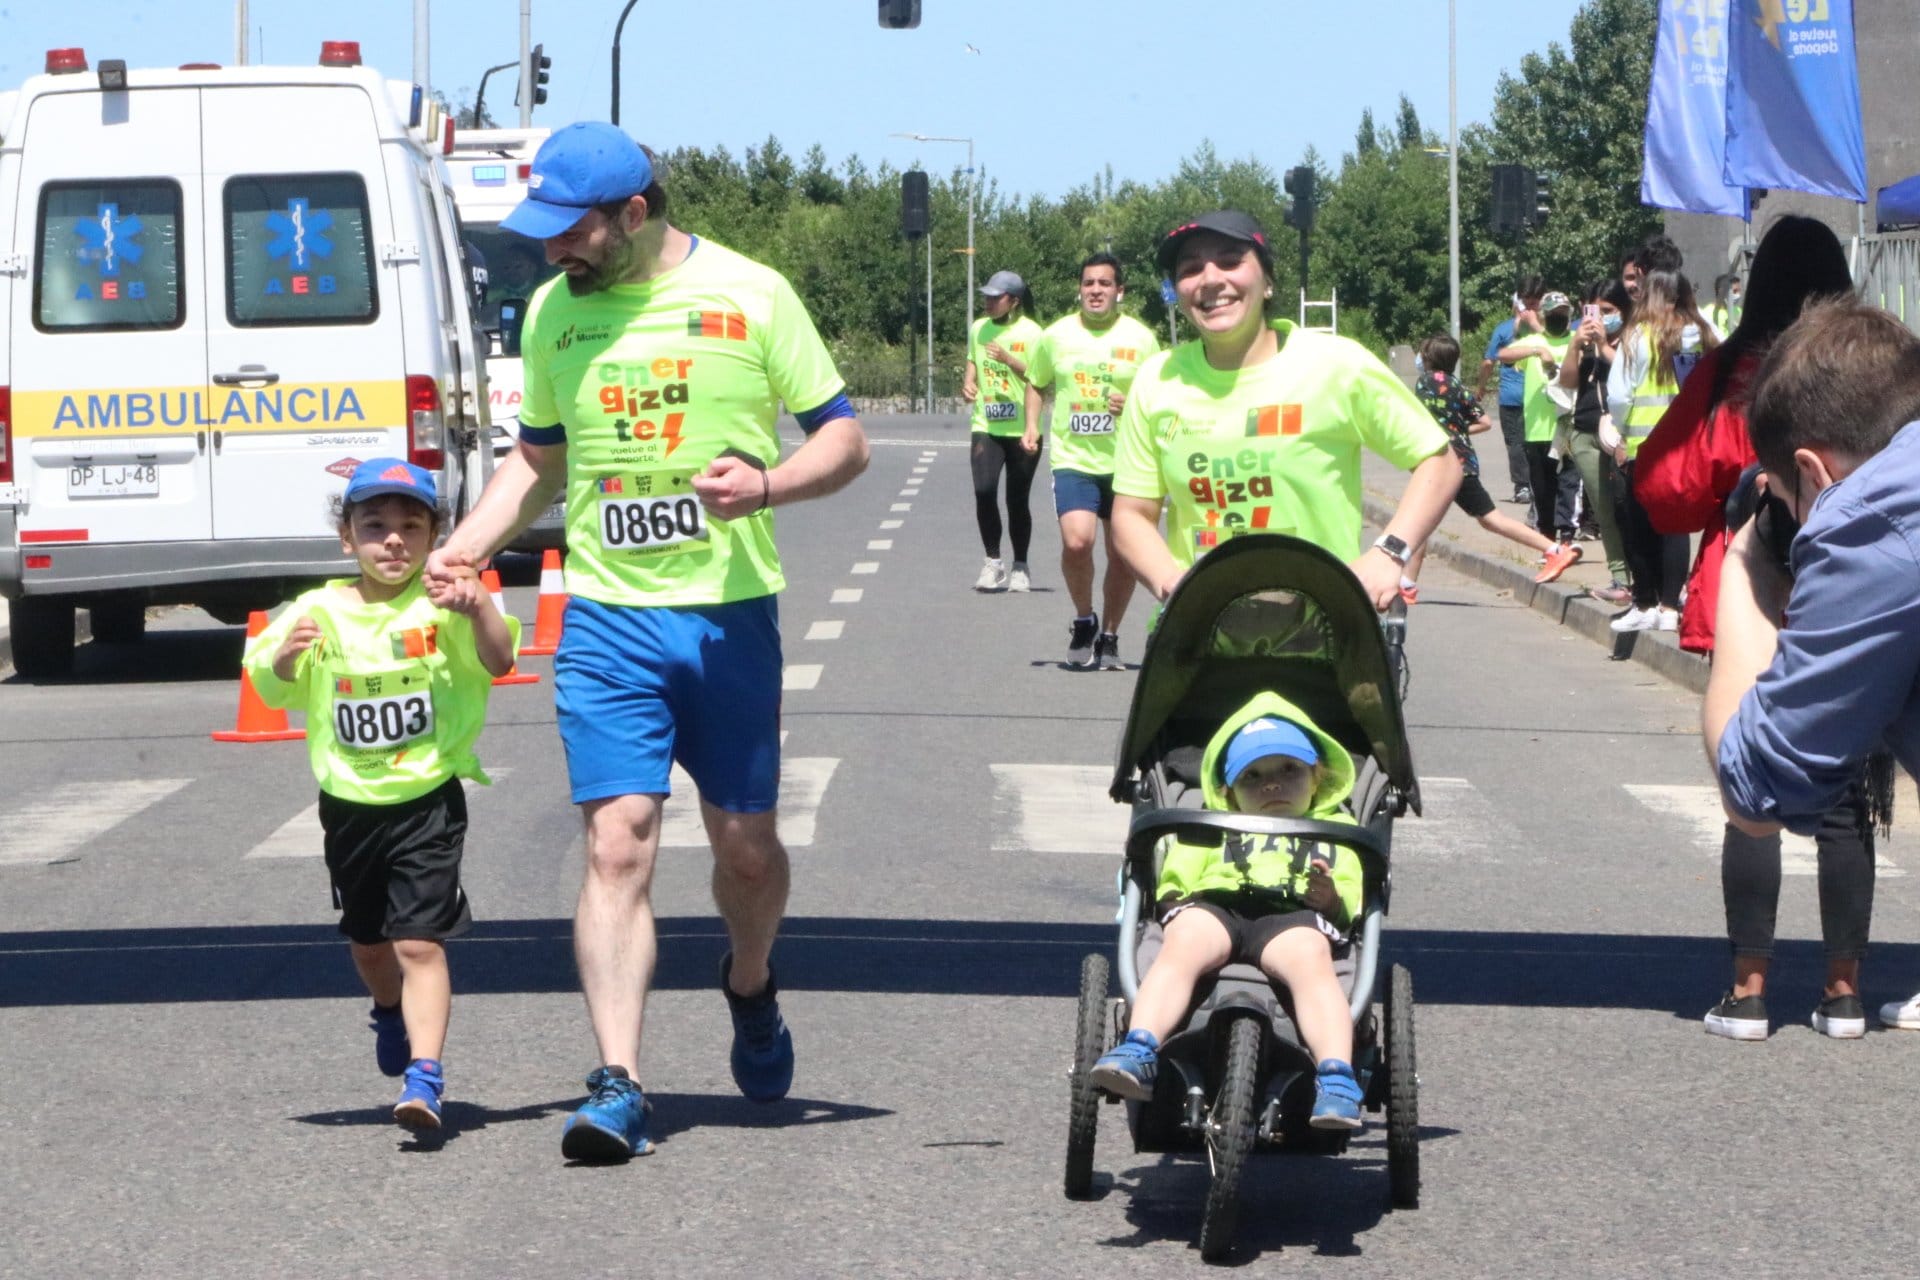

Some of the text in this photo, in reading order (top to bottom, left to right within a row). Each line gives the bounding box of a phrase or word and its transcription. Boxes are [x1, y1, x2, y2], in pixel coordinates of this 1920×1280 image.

[599, 358, 693, 386] ener
[53, 387, 365, 429] AMBULANCIA
[985, 403, 1014, 419] 0822
[614, 419, 656, 442] te
[1071, 414, 1112, 433] 0922
[1187, 449, 1276, 479] ener
[605, 498, 699, 545] 0860
[337, 697, 427, 744] 0803
